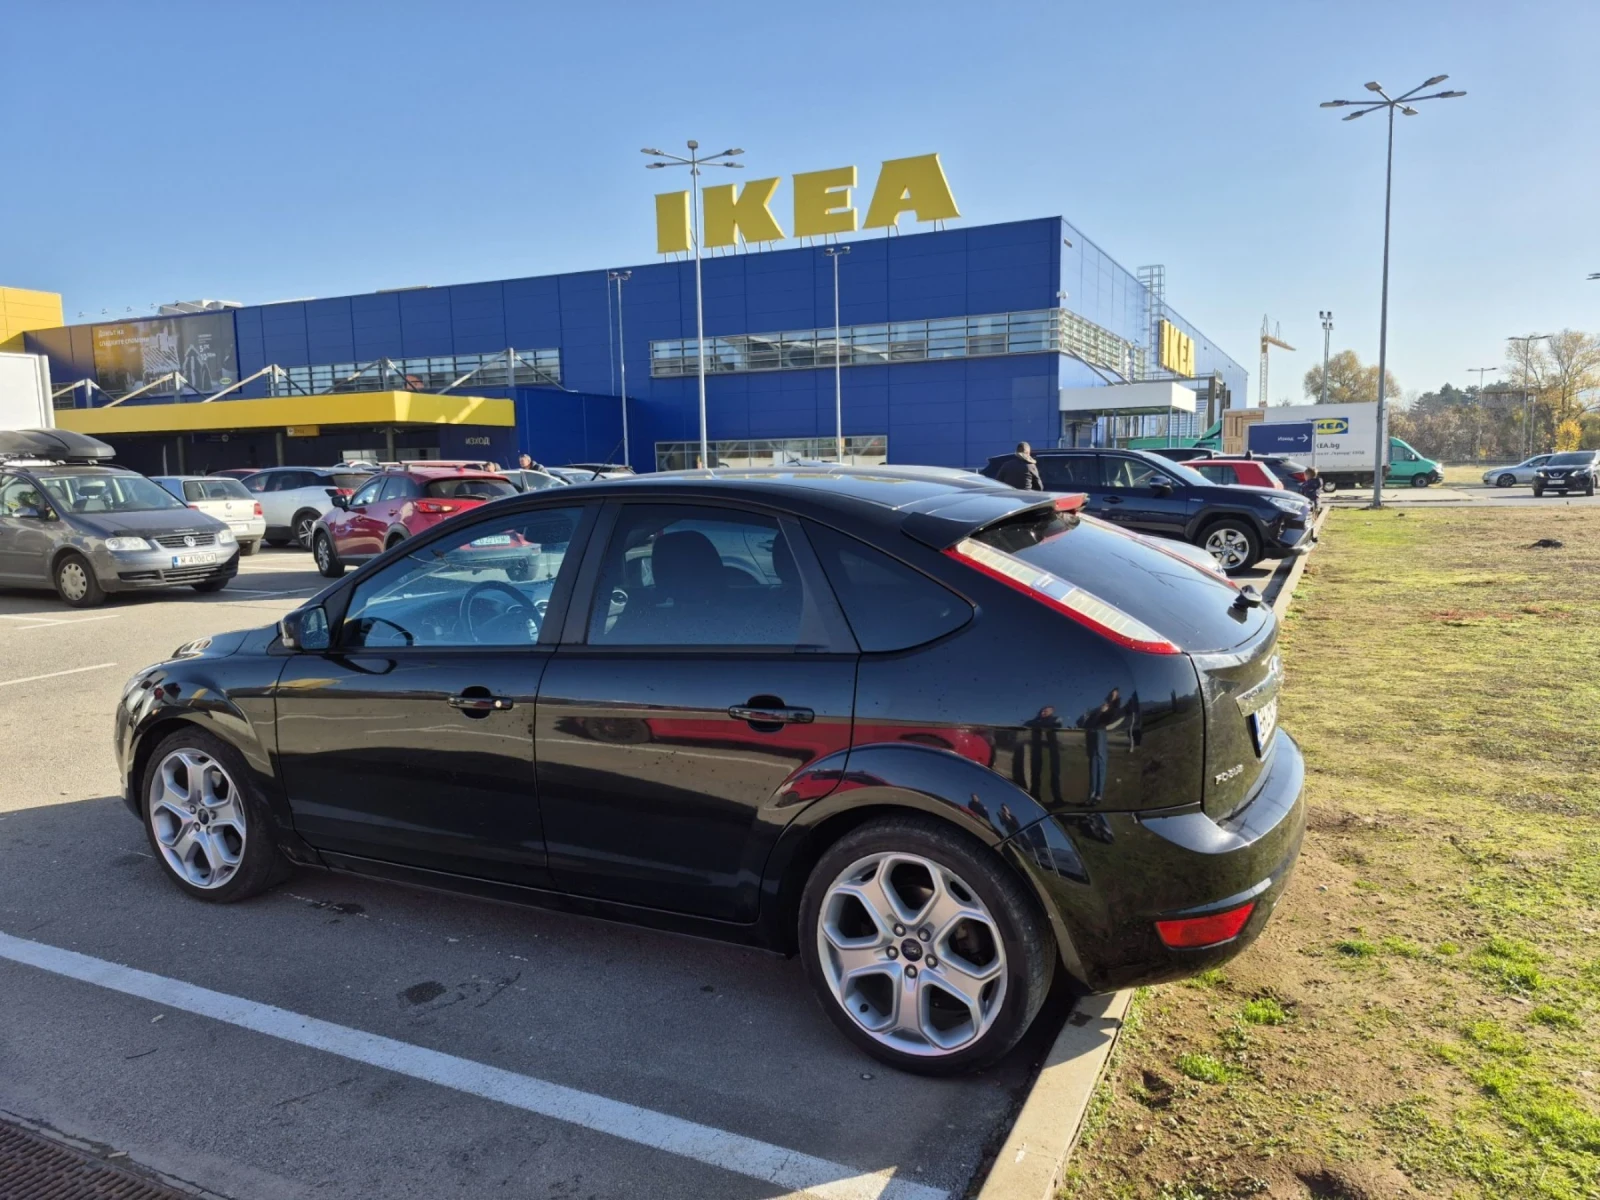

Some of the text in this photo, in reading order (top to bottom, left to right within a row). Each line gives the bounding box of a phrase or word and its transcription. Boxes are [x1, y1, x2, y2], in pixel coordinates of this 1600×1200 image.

[654, 153, 961, 254] IKEA
[1317, 422, 1345, 430] KEA
[465, 436, 490, 446] ИЗХОД
[1316, 441, 1340, 449] KEA.bg
